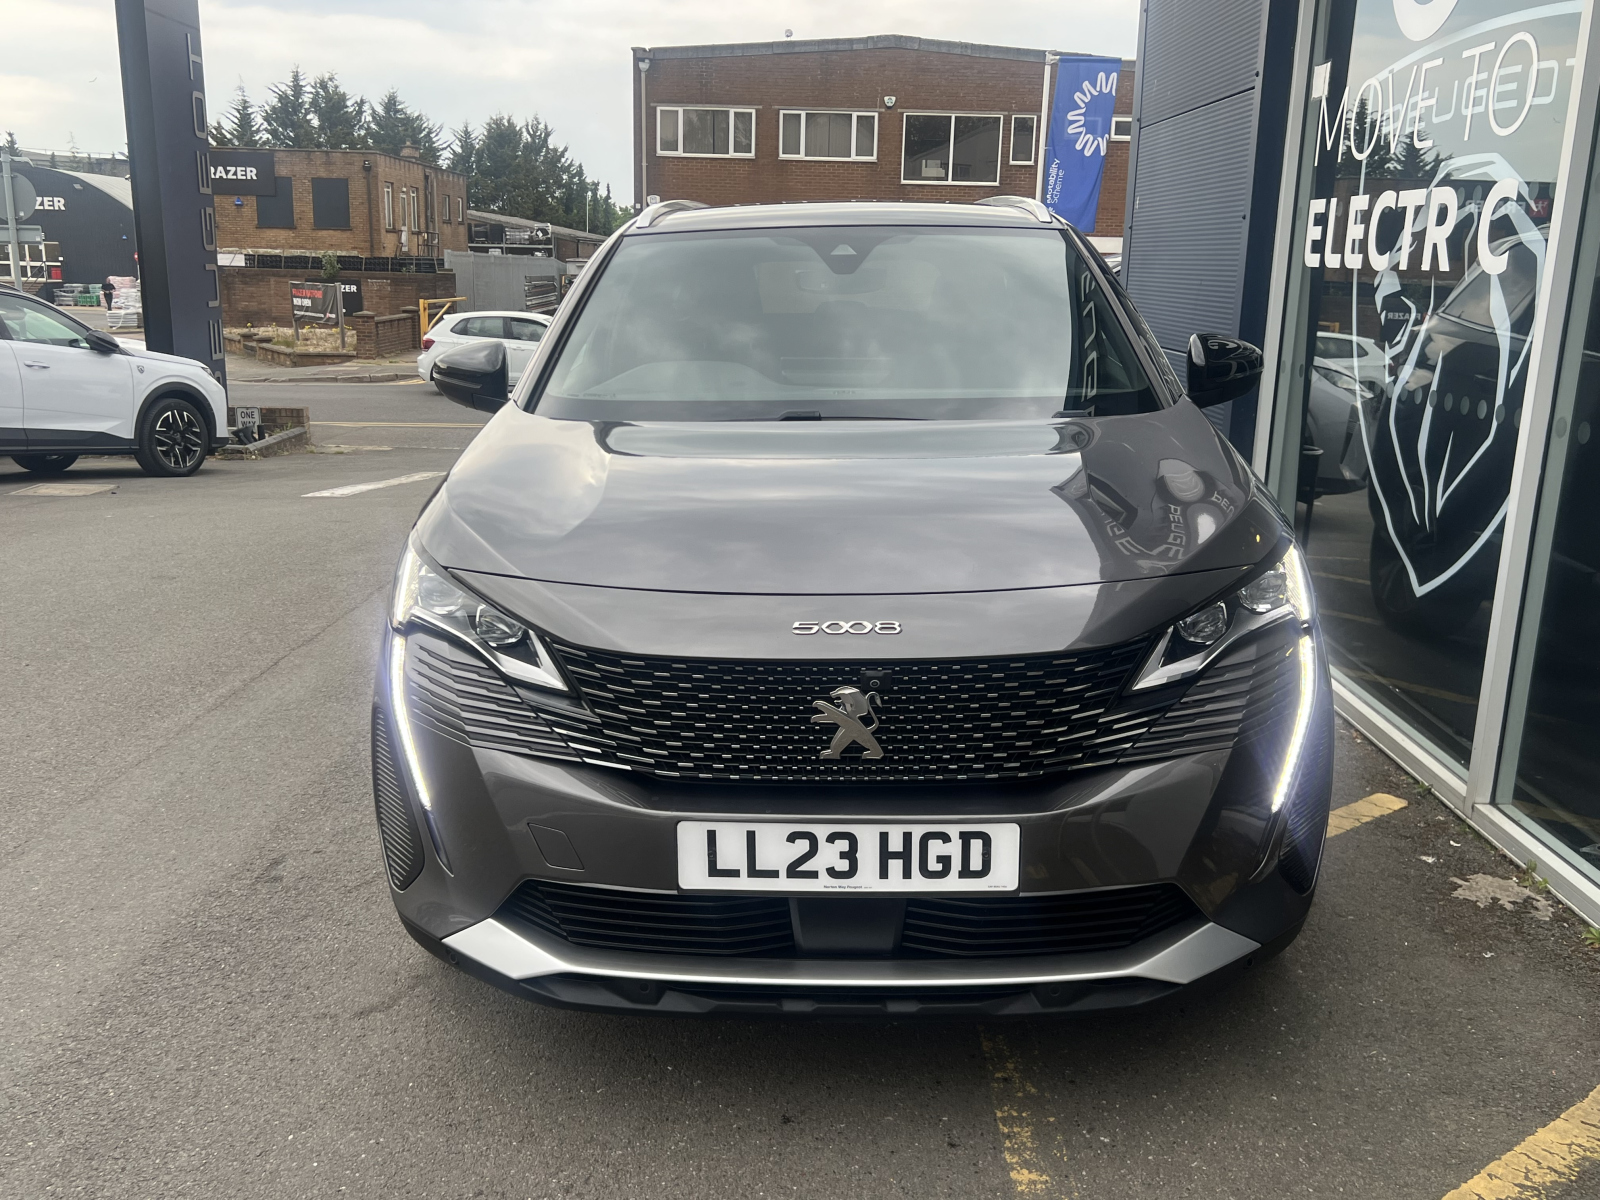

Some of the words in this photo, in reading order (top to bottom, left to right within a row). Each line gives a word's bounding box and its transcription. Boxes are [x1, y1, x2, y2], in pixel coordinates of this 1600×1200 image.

[1314, 57, 1444, 167] MOVE
[1461, 31, 1538, 137] TO
[1380, 58, 1576, 146] PEUGEO
[1047, 158, 1060, 204] Motability
[1051, 169, 1065, 204] Scheme
[240, 410, 256, 419] ONE
[791, 620, 903, 635] 5008
[706, 829, 859, 880] LL23
[878, 831, 992, 880] HGD
